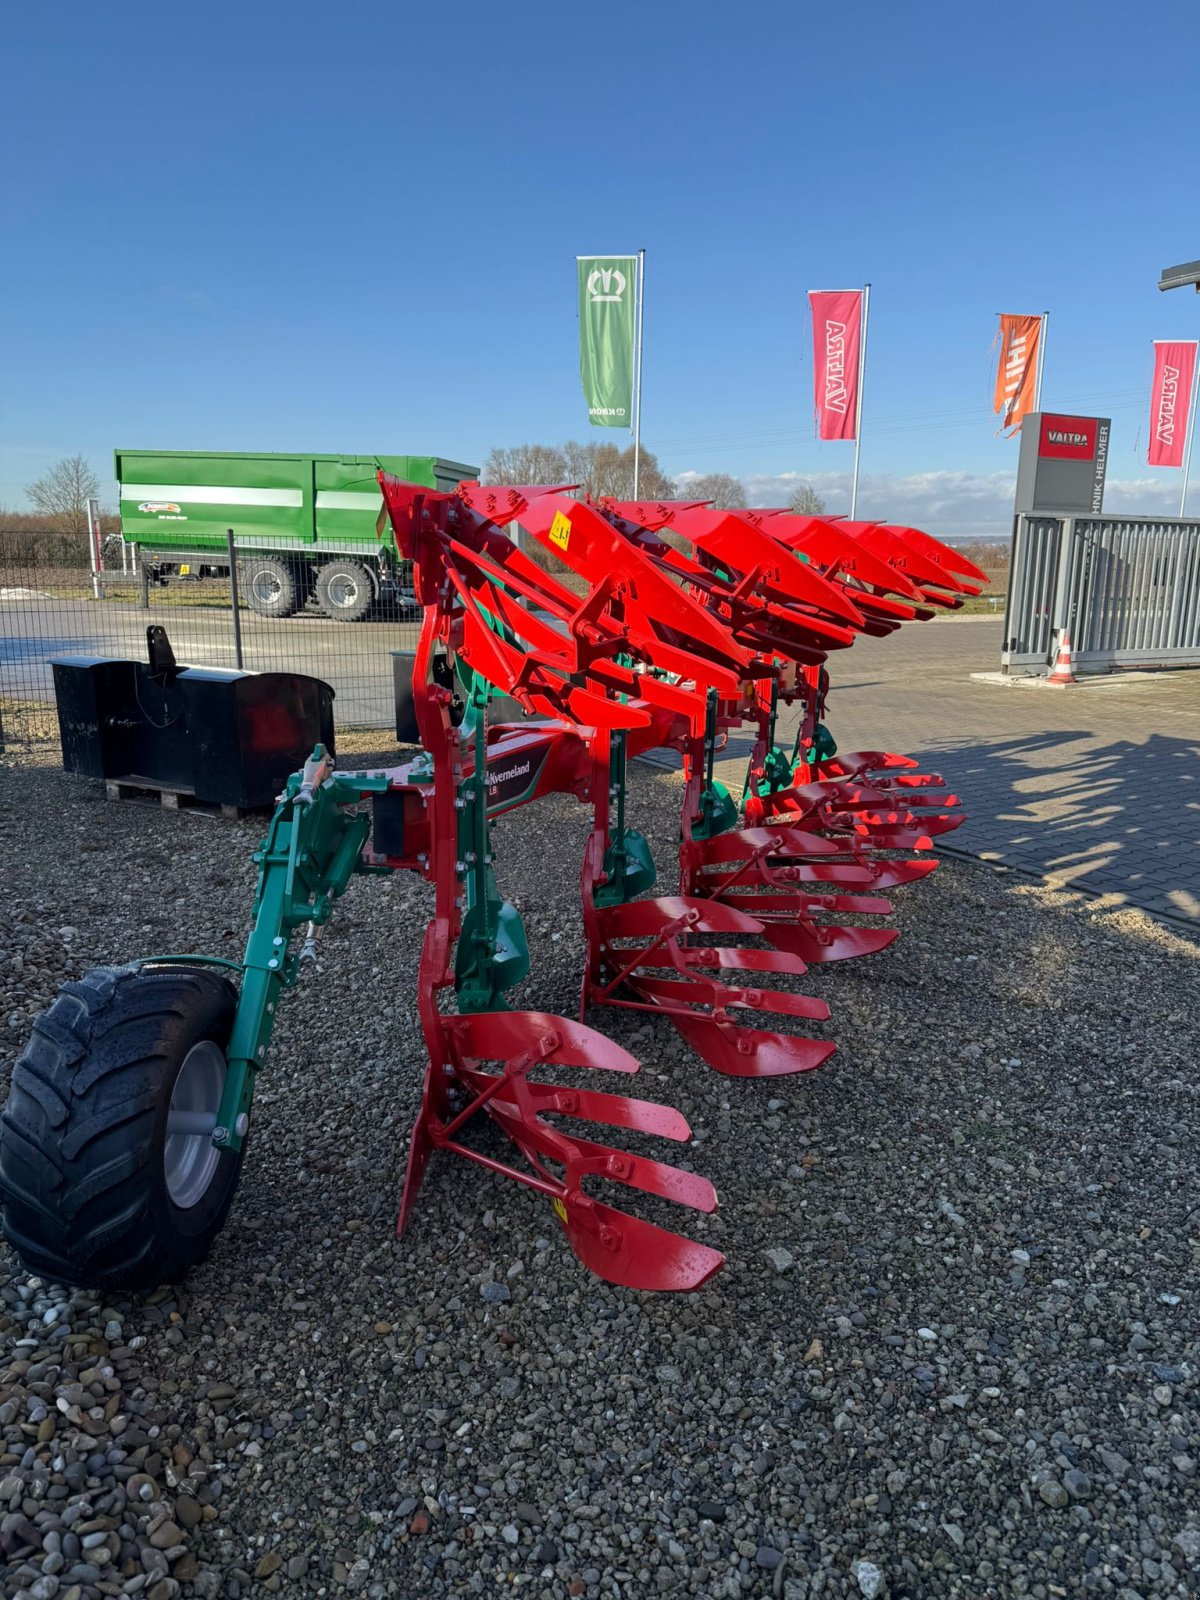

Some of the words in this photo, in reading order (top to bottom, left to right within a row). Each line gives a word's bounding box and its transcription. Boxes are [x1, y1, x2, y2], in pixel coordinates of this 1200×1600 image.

[1047, 430, 1088, 446] VALTRA
[1095, 426, 1109, 480] HELMER
[1091, 483, 1103, 514] HNIK
[489, 760, 530, 785] Kverneland
[489, 785, 498, 796] LB
